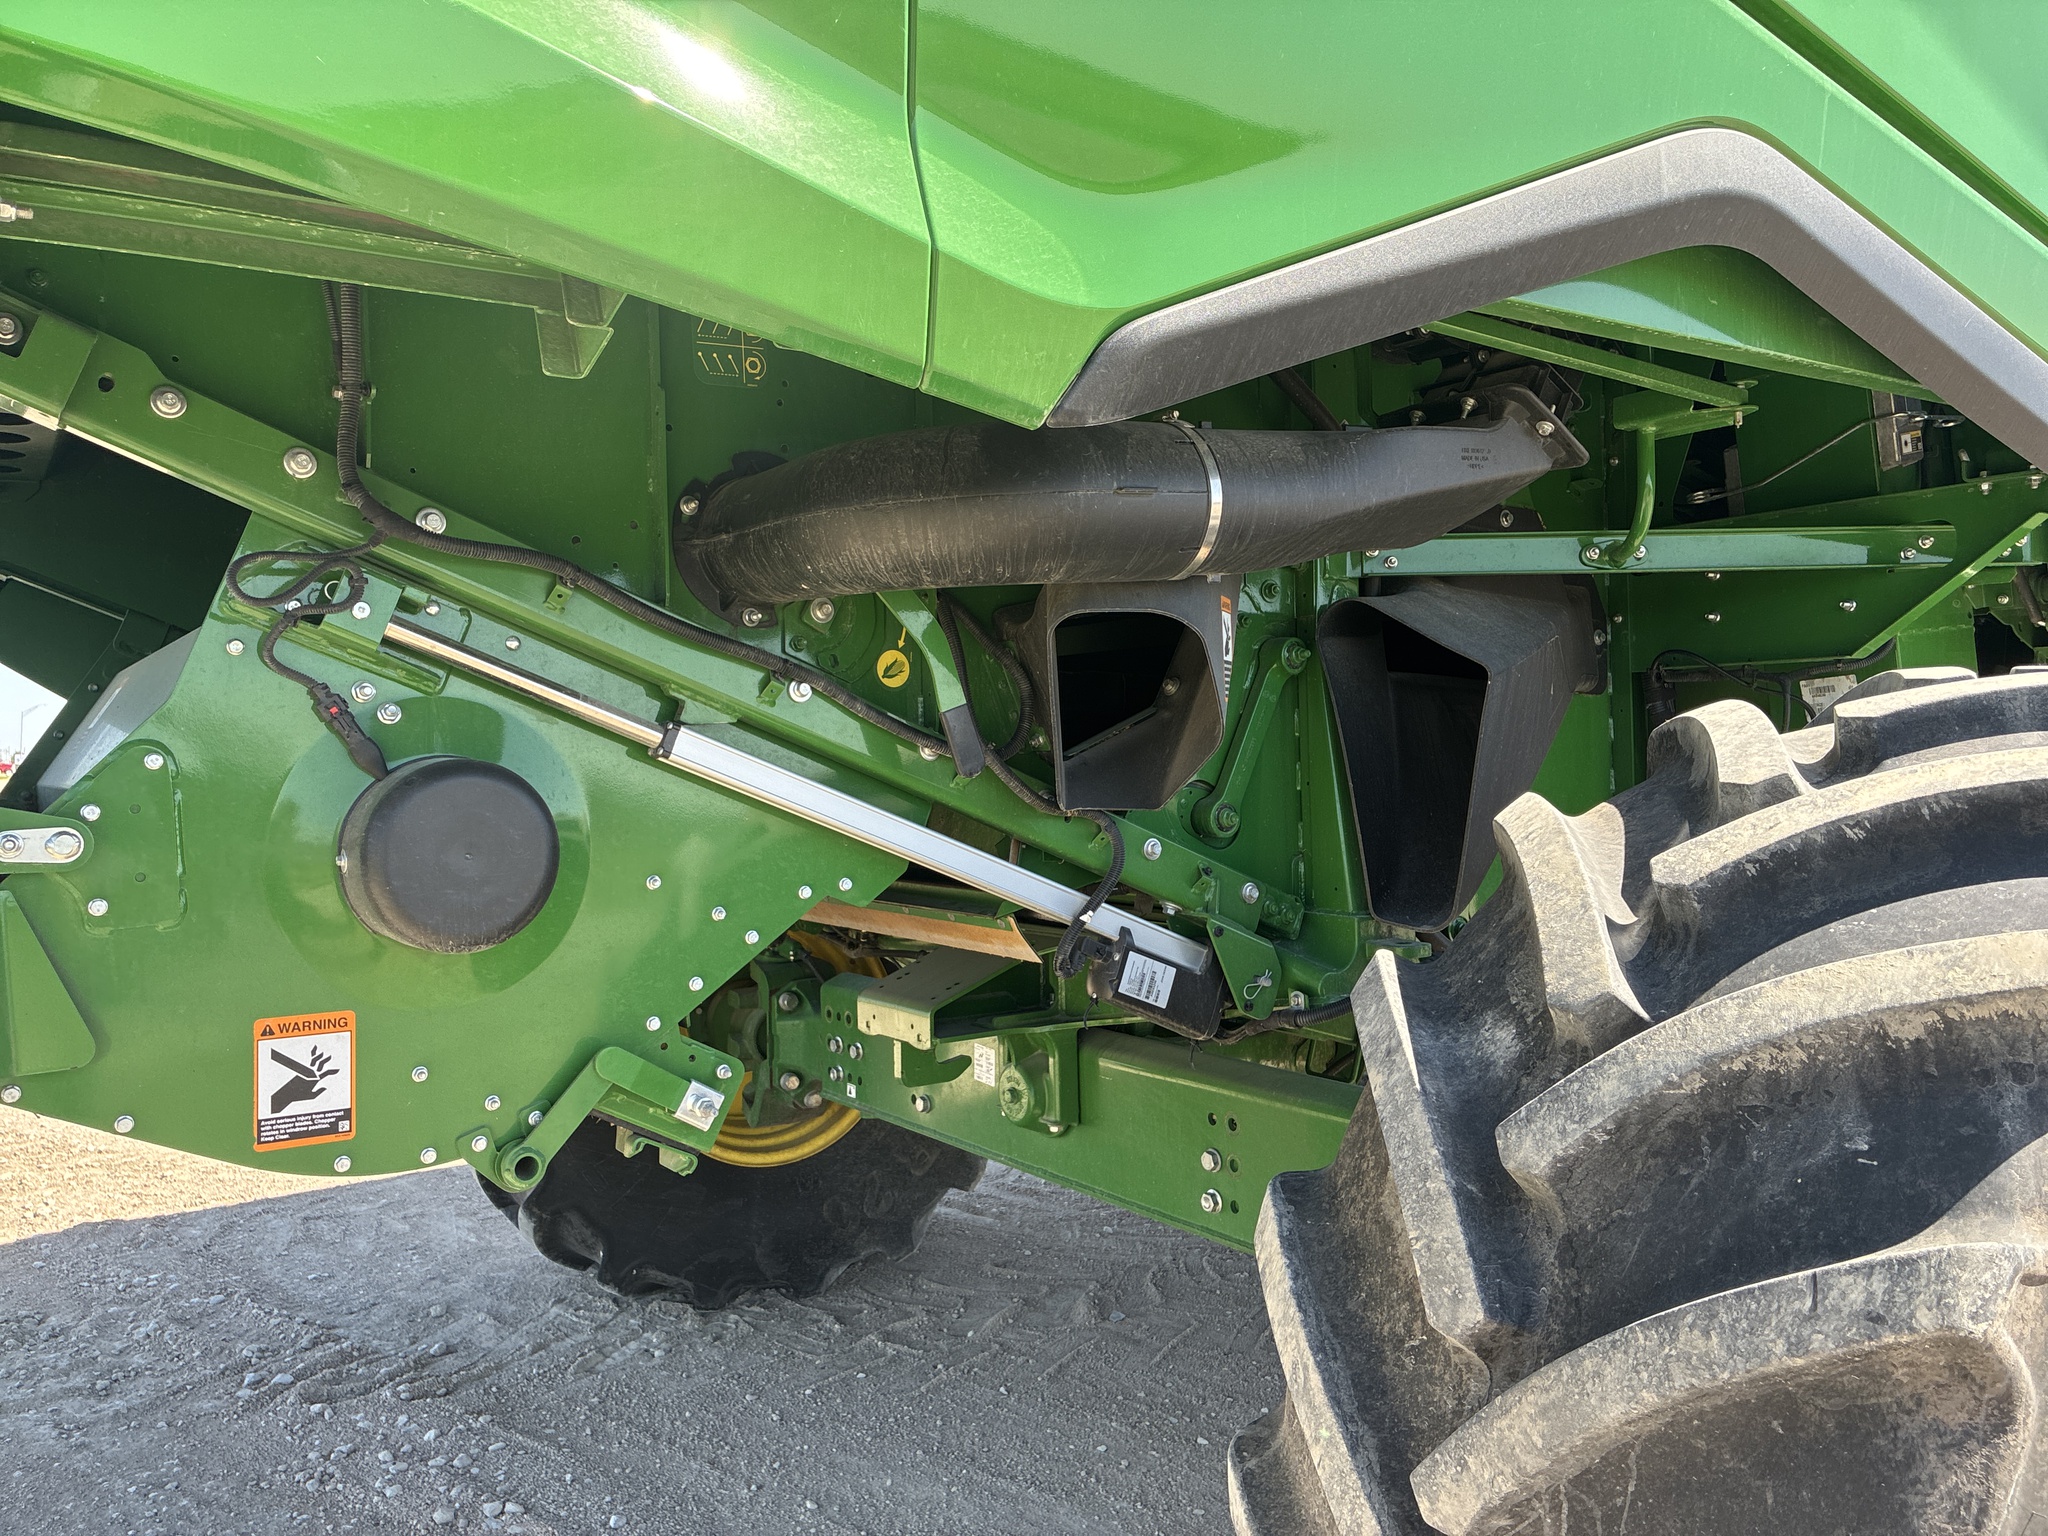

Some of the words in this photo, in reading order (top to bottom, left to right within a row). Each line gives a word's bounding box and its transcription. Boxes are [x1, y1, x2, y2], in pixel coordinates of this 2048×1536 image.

[277, 1017, 348, 1034] WARNING
[273, 1122, 294, 1130] chopper
[308, 1123, 330, 1131] position.
